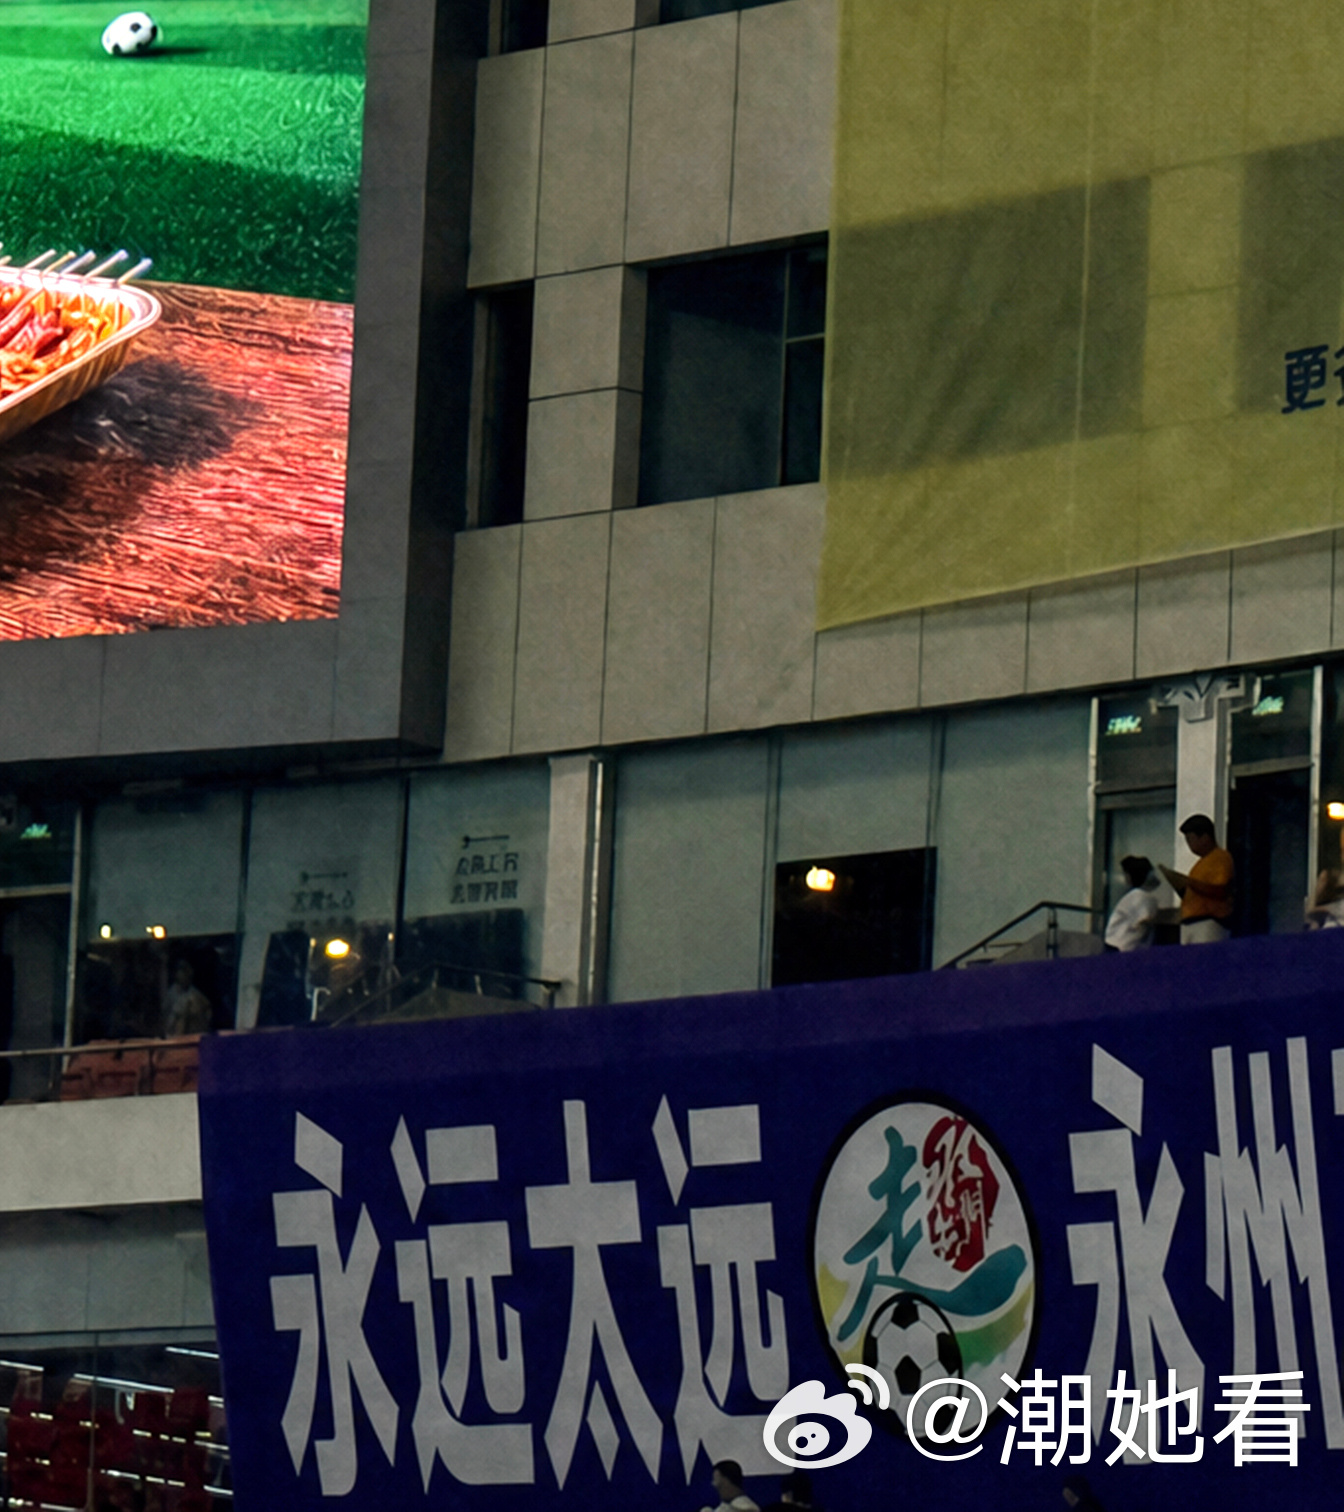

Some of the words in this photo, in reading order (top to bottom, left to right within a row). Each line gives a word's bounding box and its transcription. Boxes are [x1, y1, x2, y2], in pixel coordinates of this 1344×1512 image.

[269, 1094, 796, 1497] 永远太远
[1066, 1035, 1344, 1468] 永州
